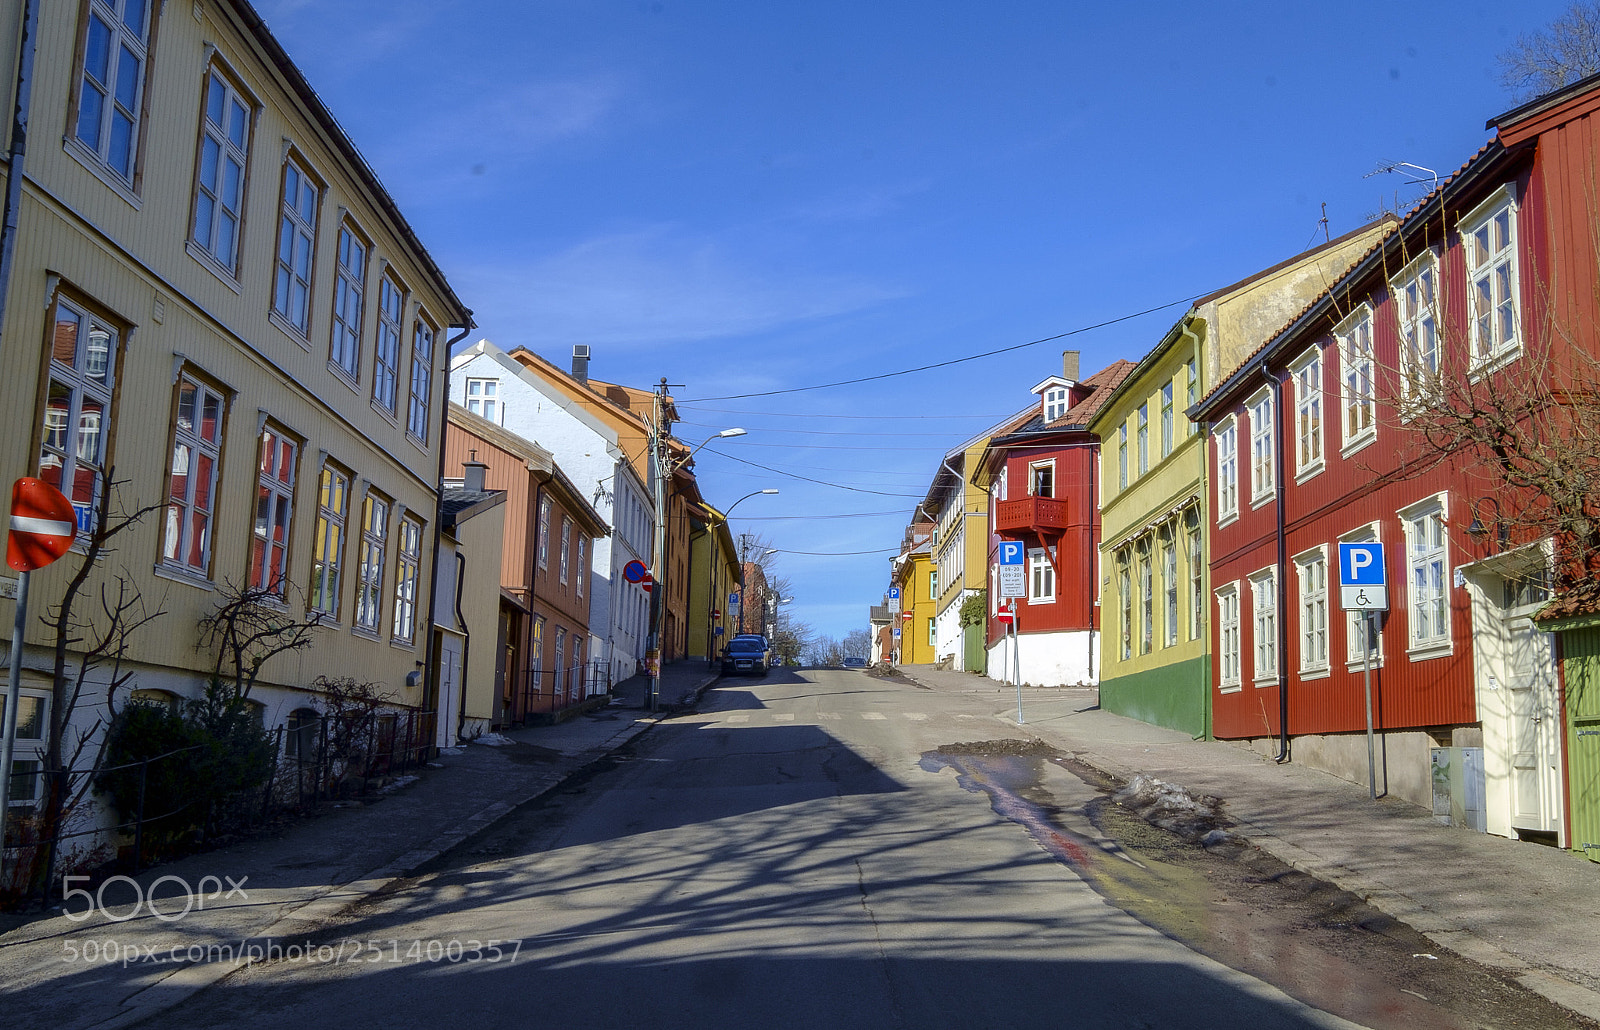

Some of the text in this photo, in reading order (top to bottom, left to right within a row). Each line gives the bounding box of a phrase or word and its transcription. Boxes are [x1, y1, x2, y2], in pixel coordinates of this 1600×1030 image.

[1004, 544, 1018, 563] P
[1349, 548, 1373, 580] P
[730, 594, 737, 603] P
[890, 589, 898, 598] P
